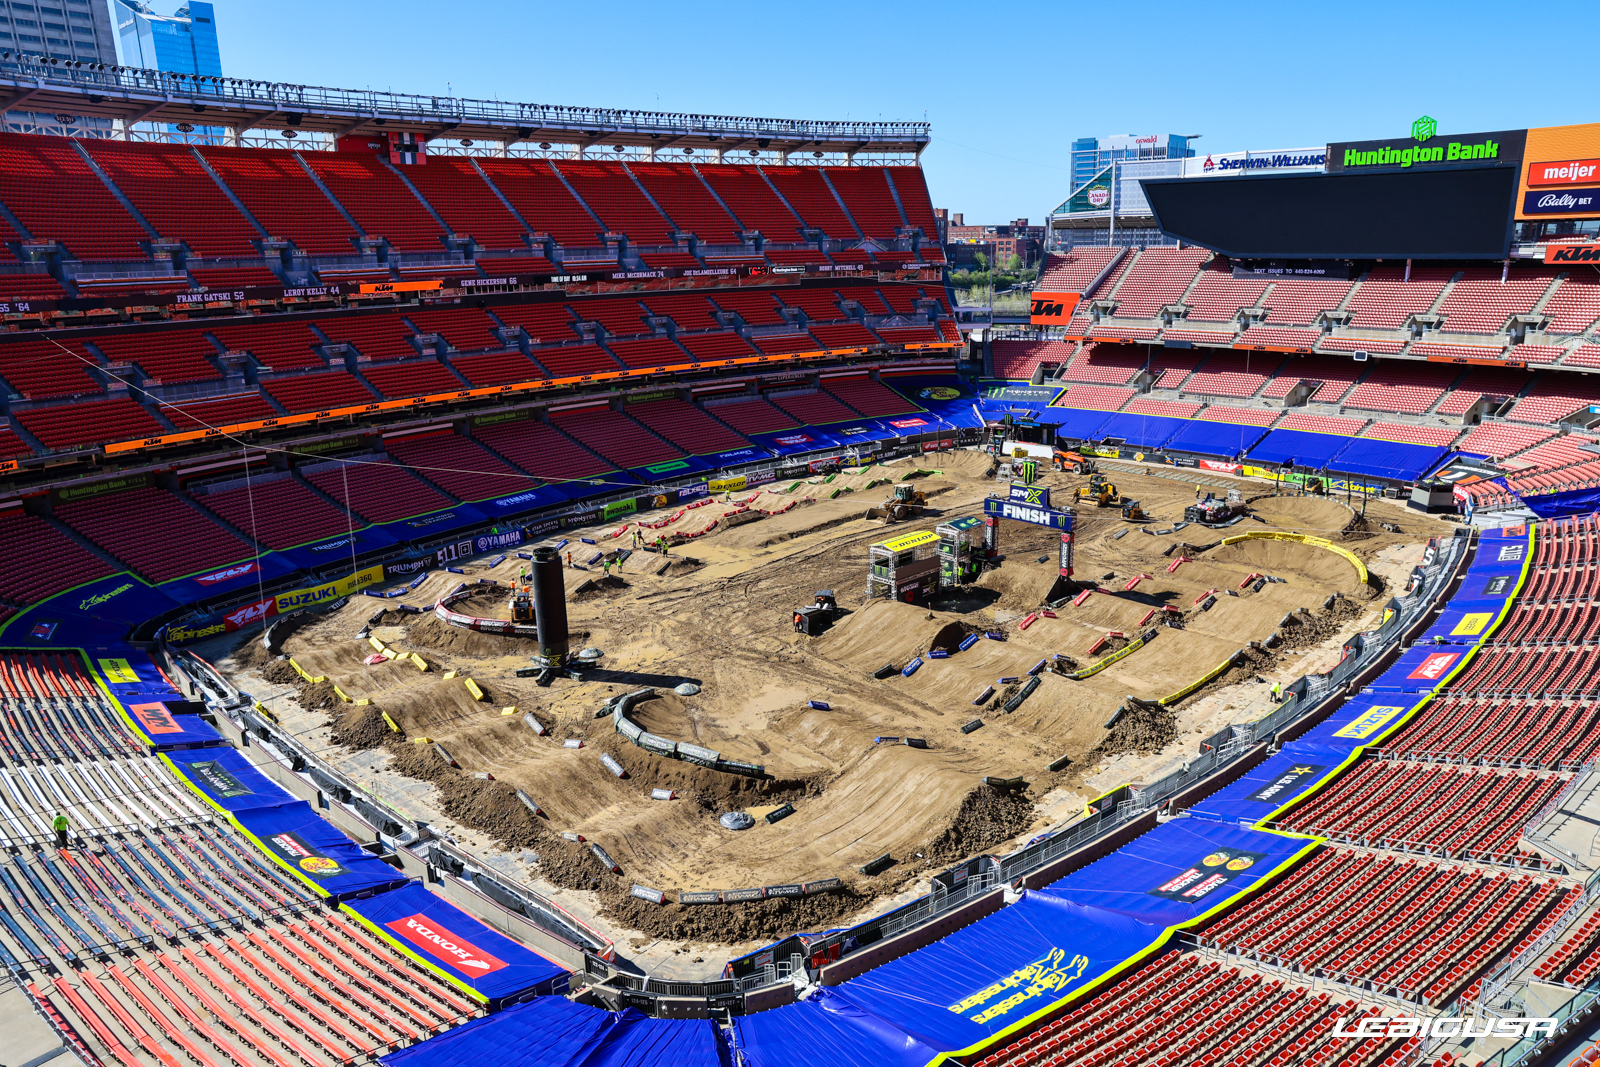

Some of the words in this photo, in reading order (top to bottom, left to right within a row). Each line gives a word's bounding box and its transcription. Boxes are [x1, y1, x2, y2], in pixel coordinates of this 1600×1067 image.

[1135, 135, 1158, 145] oswald
[1343, 146, 1444, 168] Huntington
[1447, 140, 1499, 161] Bank
[1218, 154, 1326, 171] SHERWIN-WILLIAMS
[1544, 162, 1597, 181] meijer
[1087, 192, 1111, 200] CANADA
[1537, 193, 1578, 209] Bally
[1578, 197, 1593, 205] BET
[1552, 246, 1600, 261] KTM
[657, 270, 664, 278] 74
[374, 284, 394, 293] KTM
[460, 279, 475, 287] GENE
[476, 278, 506, 286] HICKERSON
[509, 277, 517, 285] 66
[177, 294, 203, 303] FRANK
[204, 292, 231, 302] GATSKI
[234, 291, 244, 300] 52
[284, 288, 305, 297] LEROY
[306, 287, 327, 296] KELLY
[330, 286, 340, 294] 44
[15, 303, 30, 312] '64
[457, 390, 470, 398] KTM
[632, 394, 653, 402] Huntington
[365, 403, 380, 411] KTM
[315, 410, 330, 418] KTM
[480, 414, 505, 423] Huntington
[262, 419, 279, 427] KTM
[205, 428, 222, 437] KTM
[143, 437, 162, 446] KTM
[300, 443, 329, 453] Huntington
[884, 450, 897, 458] ARMY
[0, 461, 14, 470] TM
[651, 462, 685, 472] Kawasaki
[783, 467, 807, 475] MONSTER
[1205, 460, 1239, 470] FLY
[69, 483, 109, 496] Huntington
[109, 479, 127, 489] Bank
[128, 476, 147, 484] FIELD
[679, 484, 708, 497] FALKEN
[716, 481, 746, 490] DUNLOP
[1010, 488, 1043, 504] SMX
[606, 502, 633, 516] awasaki
[1003, 503, 1051, 526] FINISH
[567, 513, 597, 523] MONSTER
[312, 538, 348, 551] TRIUMPH
[487, 531, 521, 547] YAMAHA
[899, 533, 934, 547] DUNLOP
[387, 559, 425, 574] TRIUMPH
[94, 583, 134, 604] alpinestars
[278, 585, 337, 609] SUZUKI
[227, 599, 274, 625] FLY
[172, 623, 226, 643] alpinestars
[1422, 653, 1455, 679] FLY
[140, 708, 174, 728] KTM
[1343, 707, 1394, 738] SUZUKI
[200, 767, 230, 791] MONSTER
[1277, 775, 1299, 785] U.S.
[1255, 784, 1285, 801] ARMY
[271, 836, 303, 857] TRACKER
[1169, 872, 1204, 892] TRACKER
[1191, 877, 1228, 898] TRACKER
[405, 918, 474, 959] HONDA
[948, 965, 1037, 1015] alpinestars
[970, 973, 1060, 1025] alpinestars
